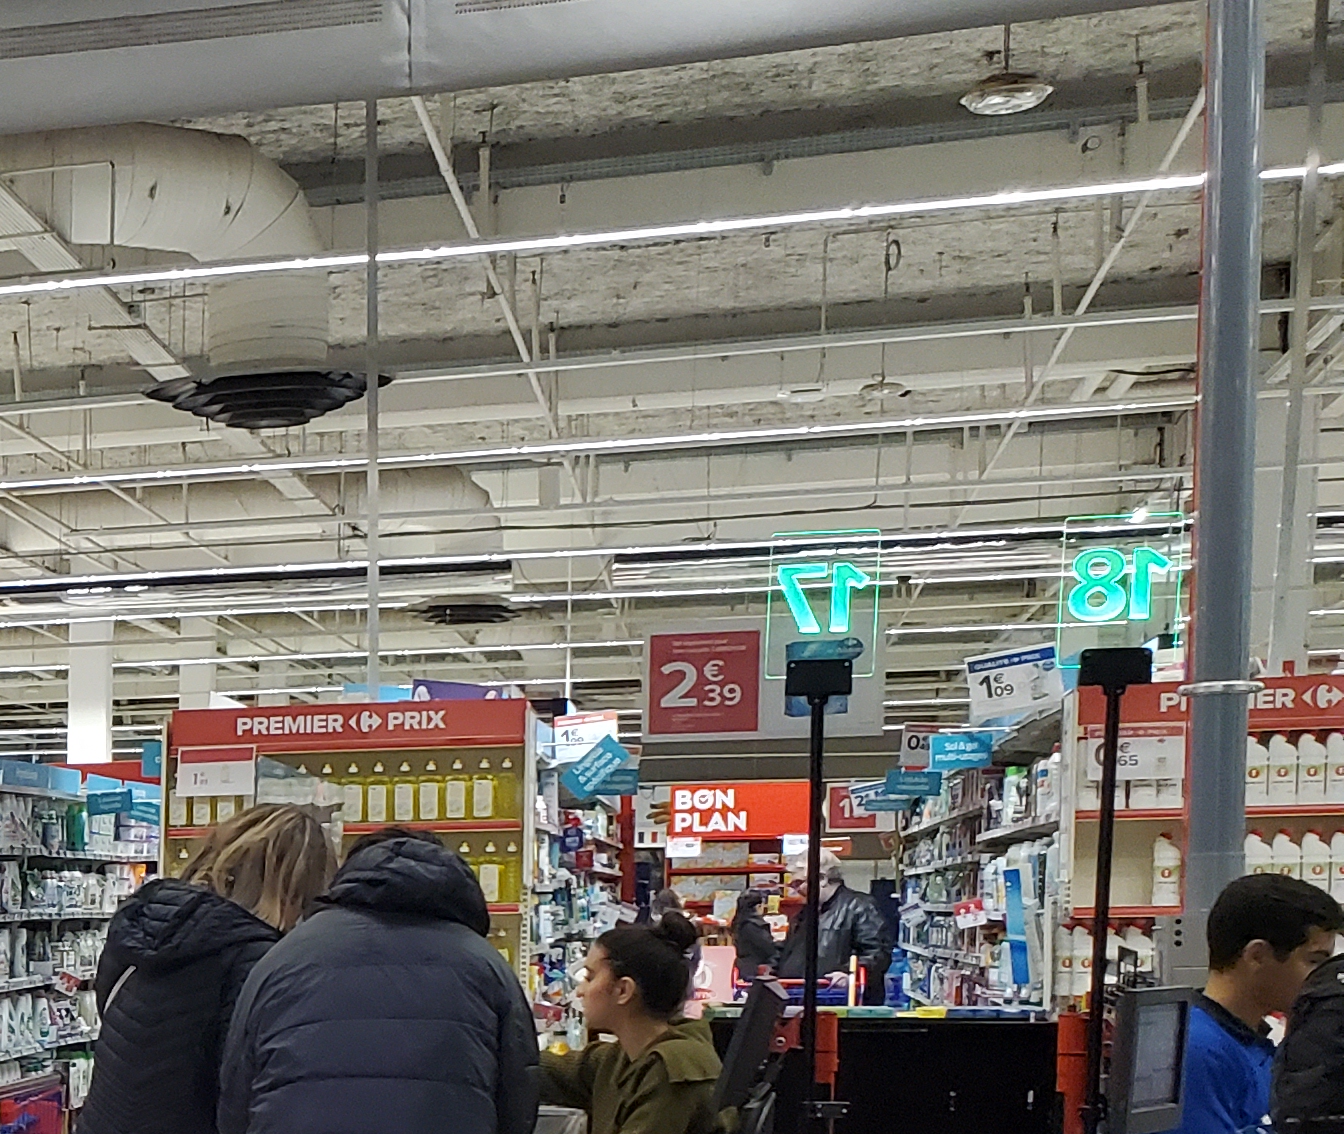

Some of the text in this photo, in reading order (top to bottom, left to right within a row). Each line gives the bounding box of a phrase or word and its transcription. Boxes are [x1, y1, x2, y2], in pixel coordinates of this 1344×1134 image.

[660, 661, 698, 708] 2
[702, 683, 742, 707] 39
[1159, 688, 1296, 713] PIER
[236, 709, 446, 736] PREMIER PRIX
[674, 788, 735, 811] BON
[674, 811, 747, 832] PLAN
